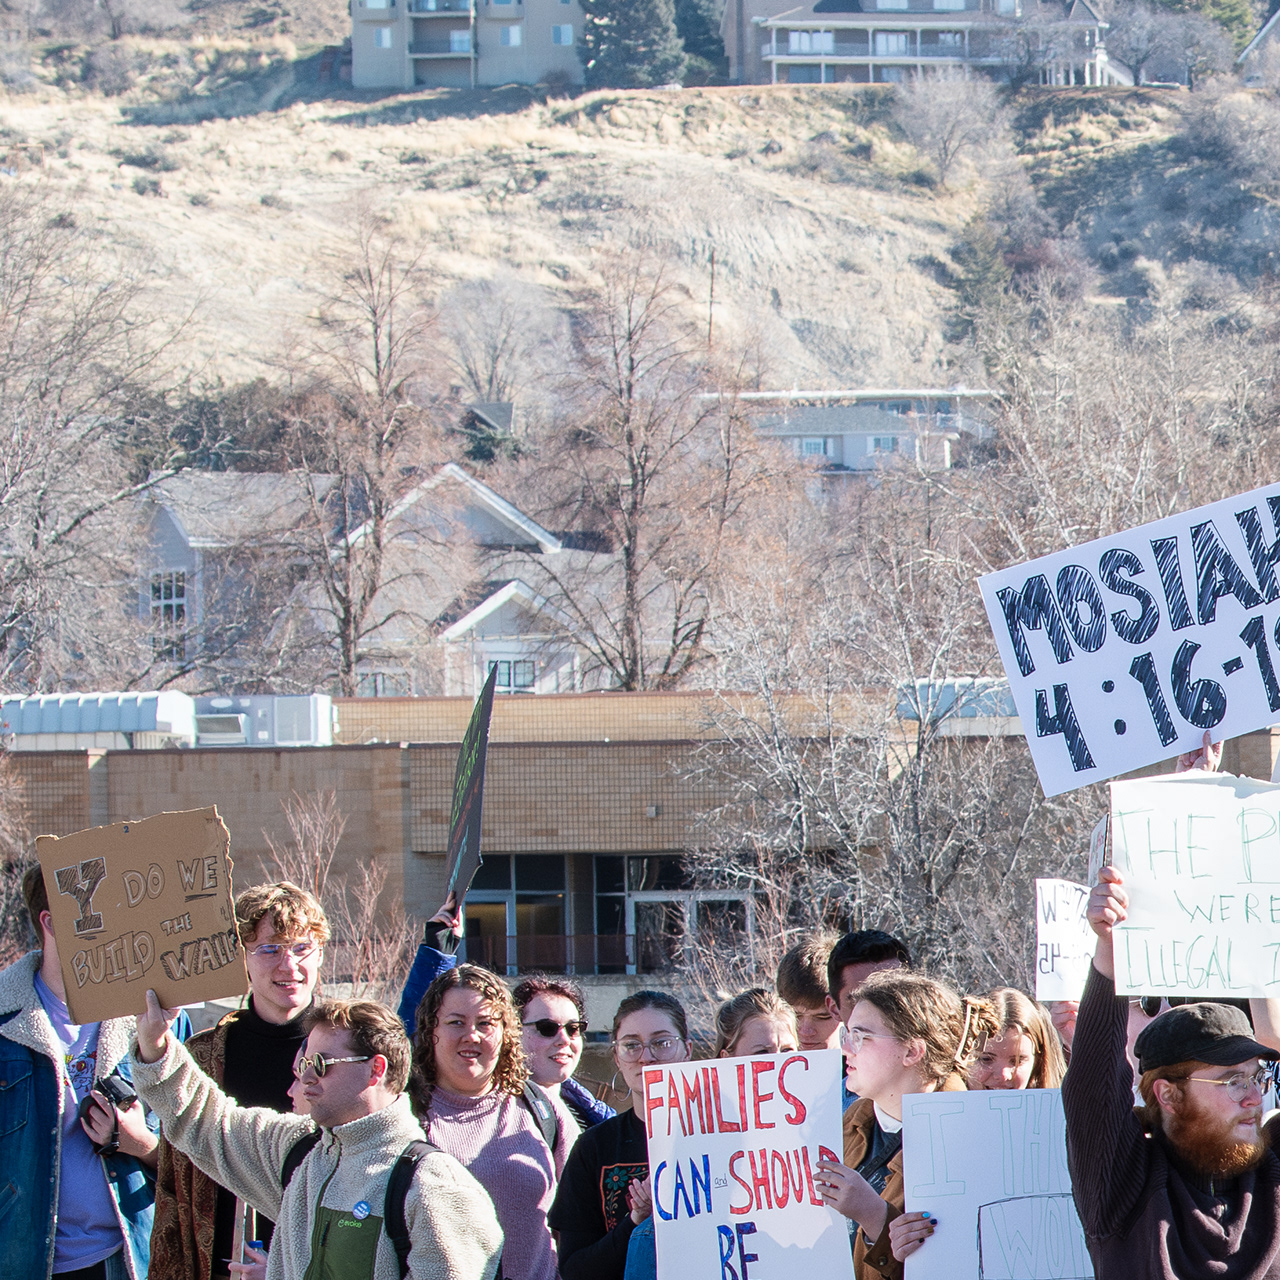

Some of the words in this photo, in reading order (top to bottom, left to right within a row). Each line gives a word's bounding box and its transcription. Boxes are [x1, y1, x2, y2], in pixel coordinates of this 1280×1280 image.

[1107, 807, 1215, 880] THE
[54, 856, 108, 935] Y
[122, 863, 165, 909] DO
[177, 855, 218, 892] WE
[71, 930, 156, 989] BUILD
[160, 912, 192, 936] THE
[1112, 925, 1251, 990] ILLEGAL
[642, 1055, 810, 1139] FAMILIES
[653, 1153, 712, 1222] CAN
[713, 1174, 729, 1189] and
